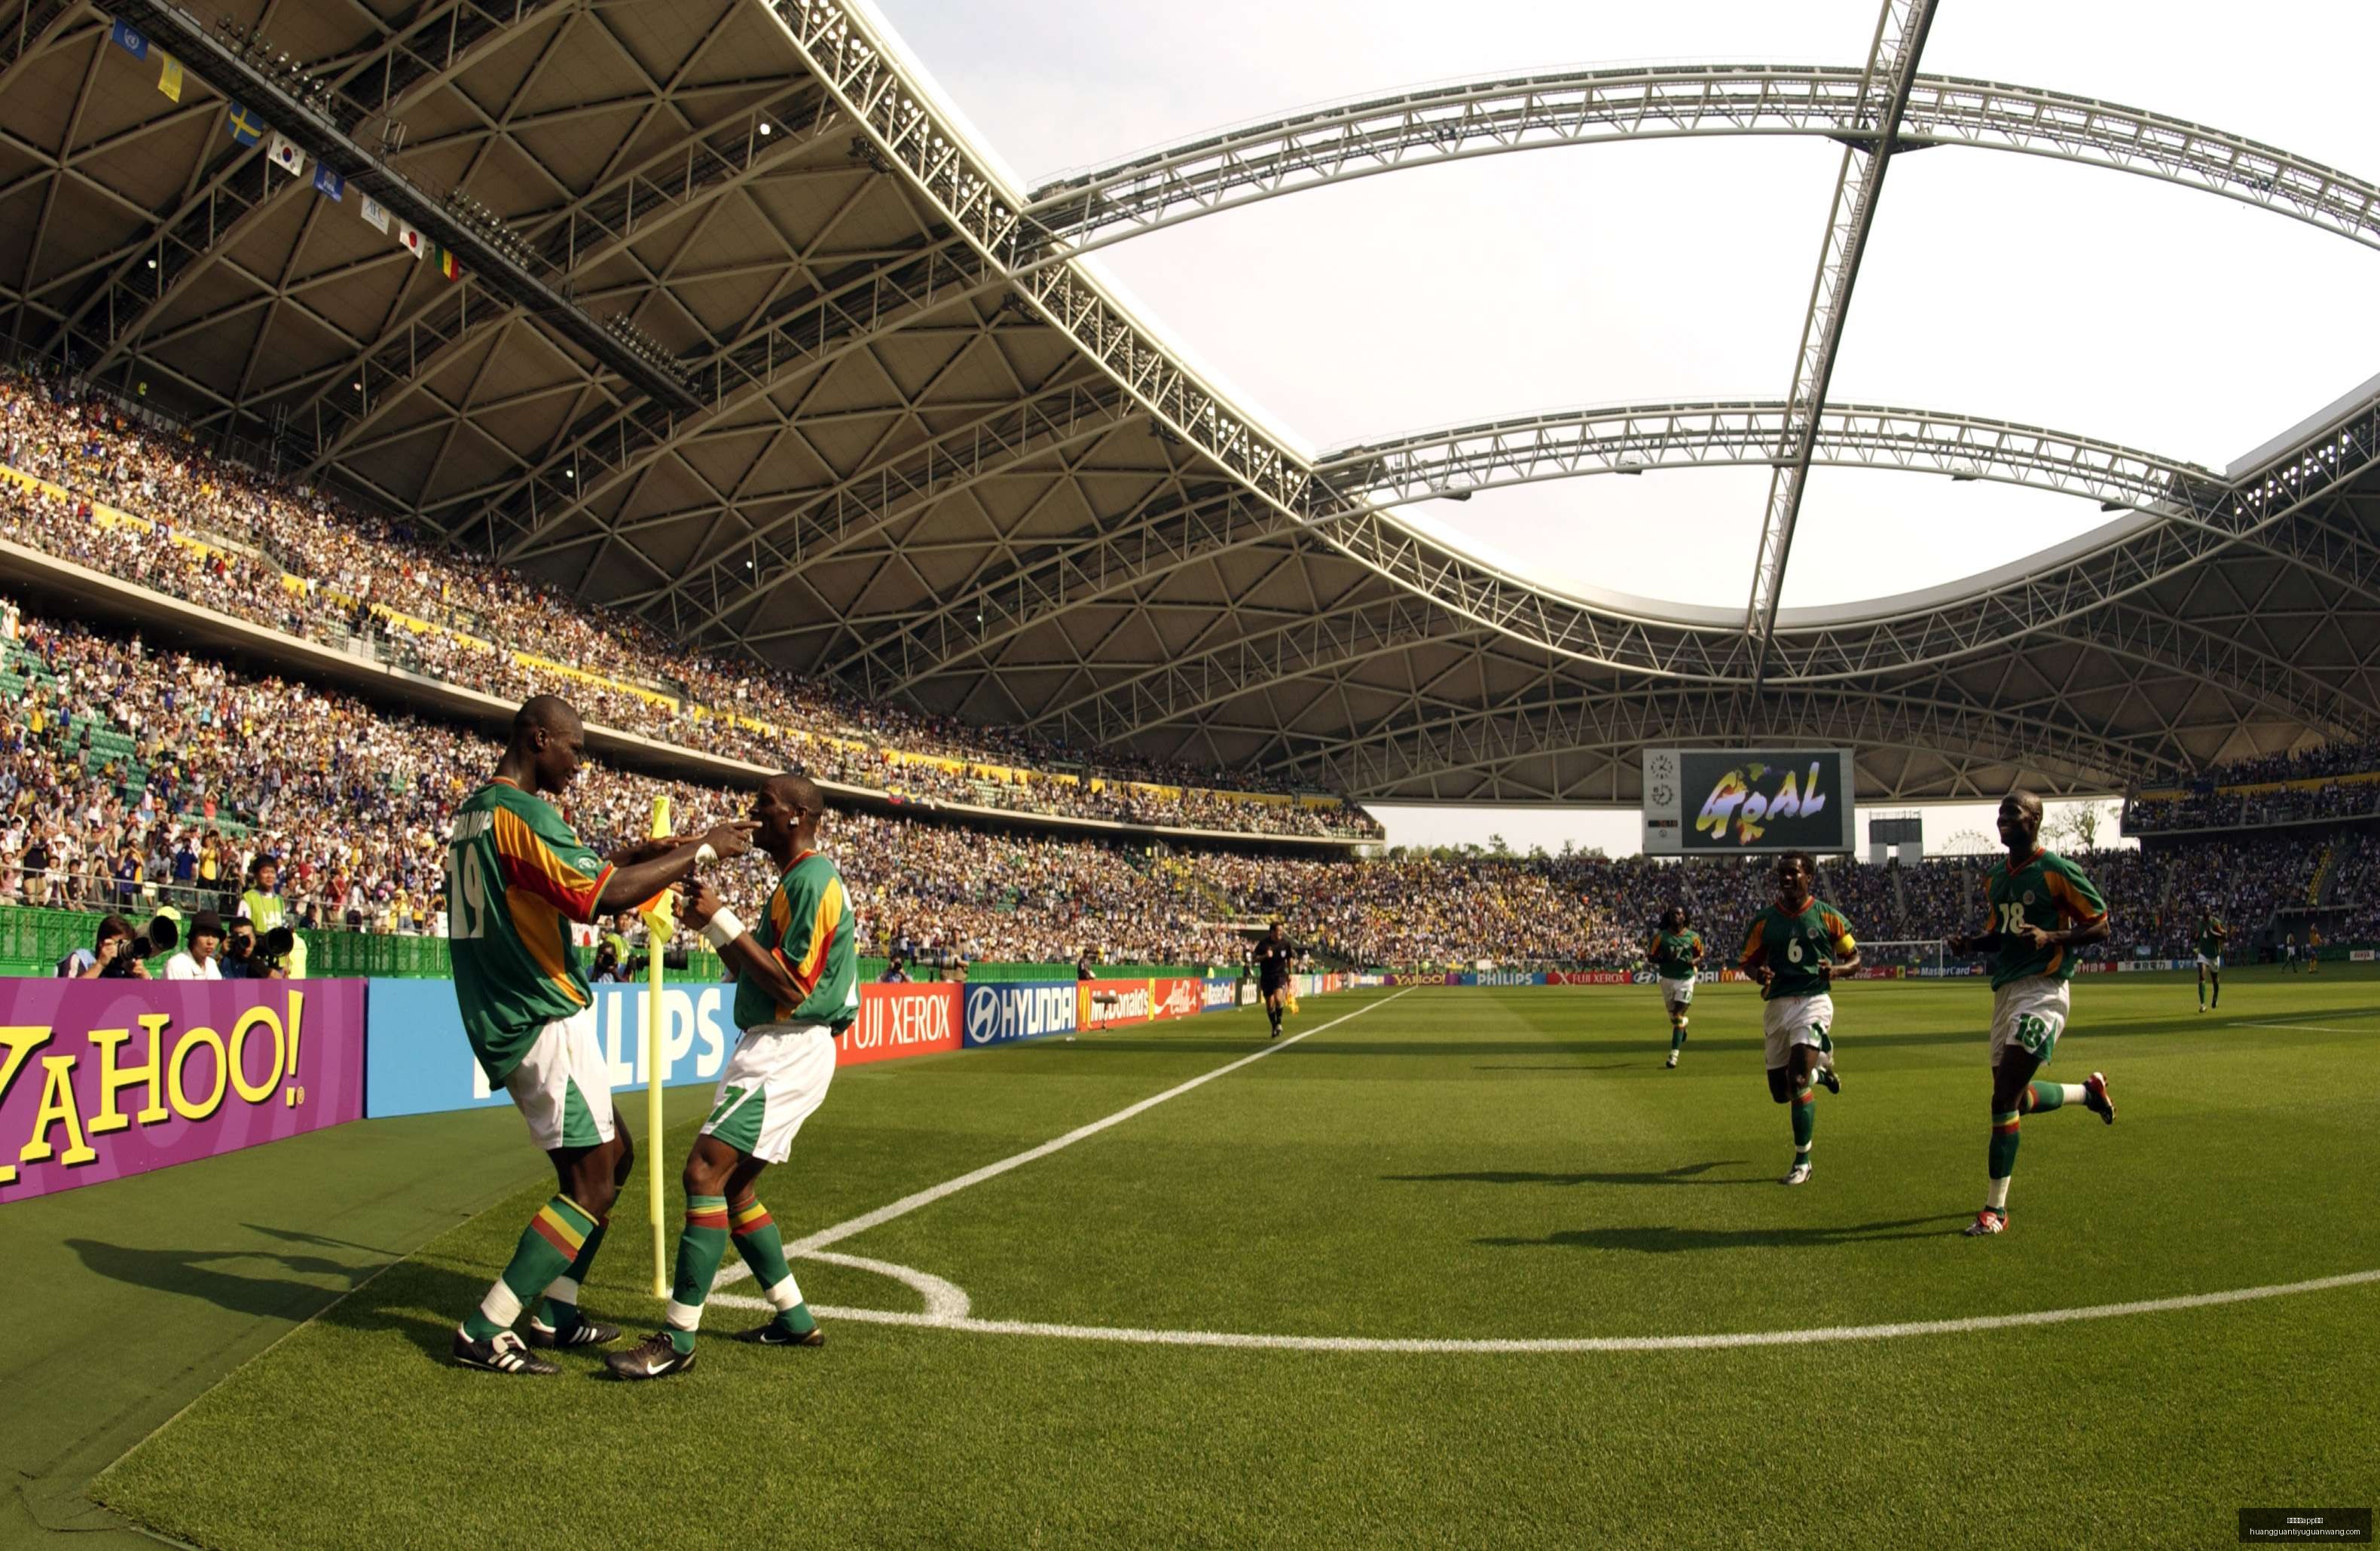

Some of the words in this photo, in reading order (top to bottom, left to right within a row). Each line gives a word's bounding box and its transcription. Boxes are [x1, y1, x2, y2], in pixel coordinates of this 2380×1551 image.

[447, 843, 485, 940] 19
[1999, 902, 2024, 934] 18
[1787, 938, 1803, 964] 6
[1393, 974, 1446, 985] YAHOO!
[1477, 972, 1533, 986] PHILIPS
[1572, 974, 1590, 984] FUJI
[1593, 973, 1625, 984] XEROX
[889, 995, 951, 1045] XEROX
[1001, 987, 1077, 1038] HYUNDAI
[2015, 1012, 2047, 1050] 18
[707, 1085, 747, 1124] 7
